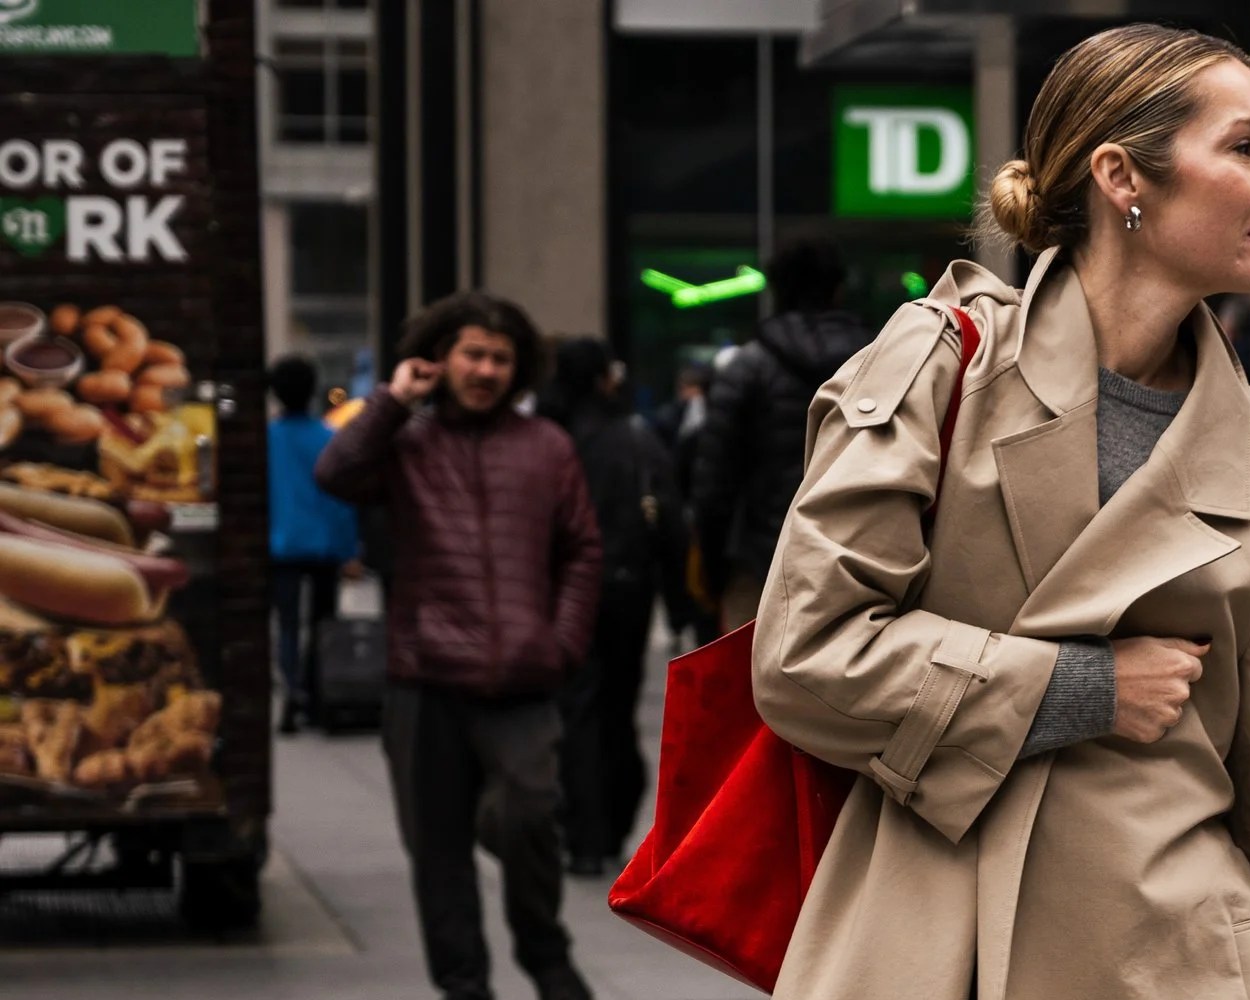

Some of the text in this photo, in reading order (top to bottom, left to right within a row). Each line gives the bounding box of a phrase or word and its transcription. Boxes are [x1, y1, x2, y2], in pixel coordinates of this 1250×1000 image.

[0, 138, 188, 189] OR OF
[843, 105, 971, 194] TD
